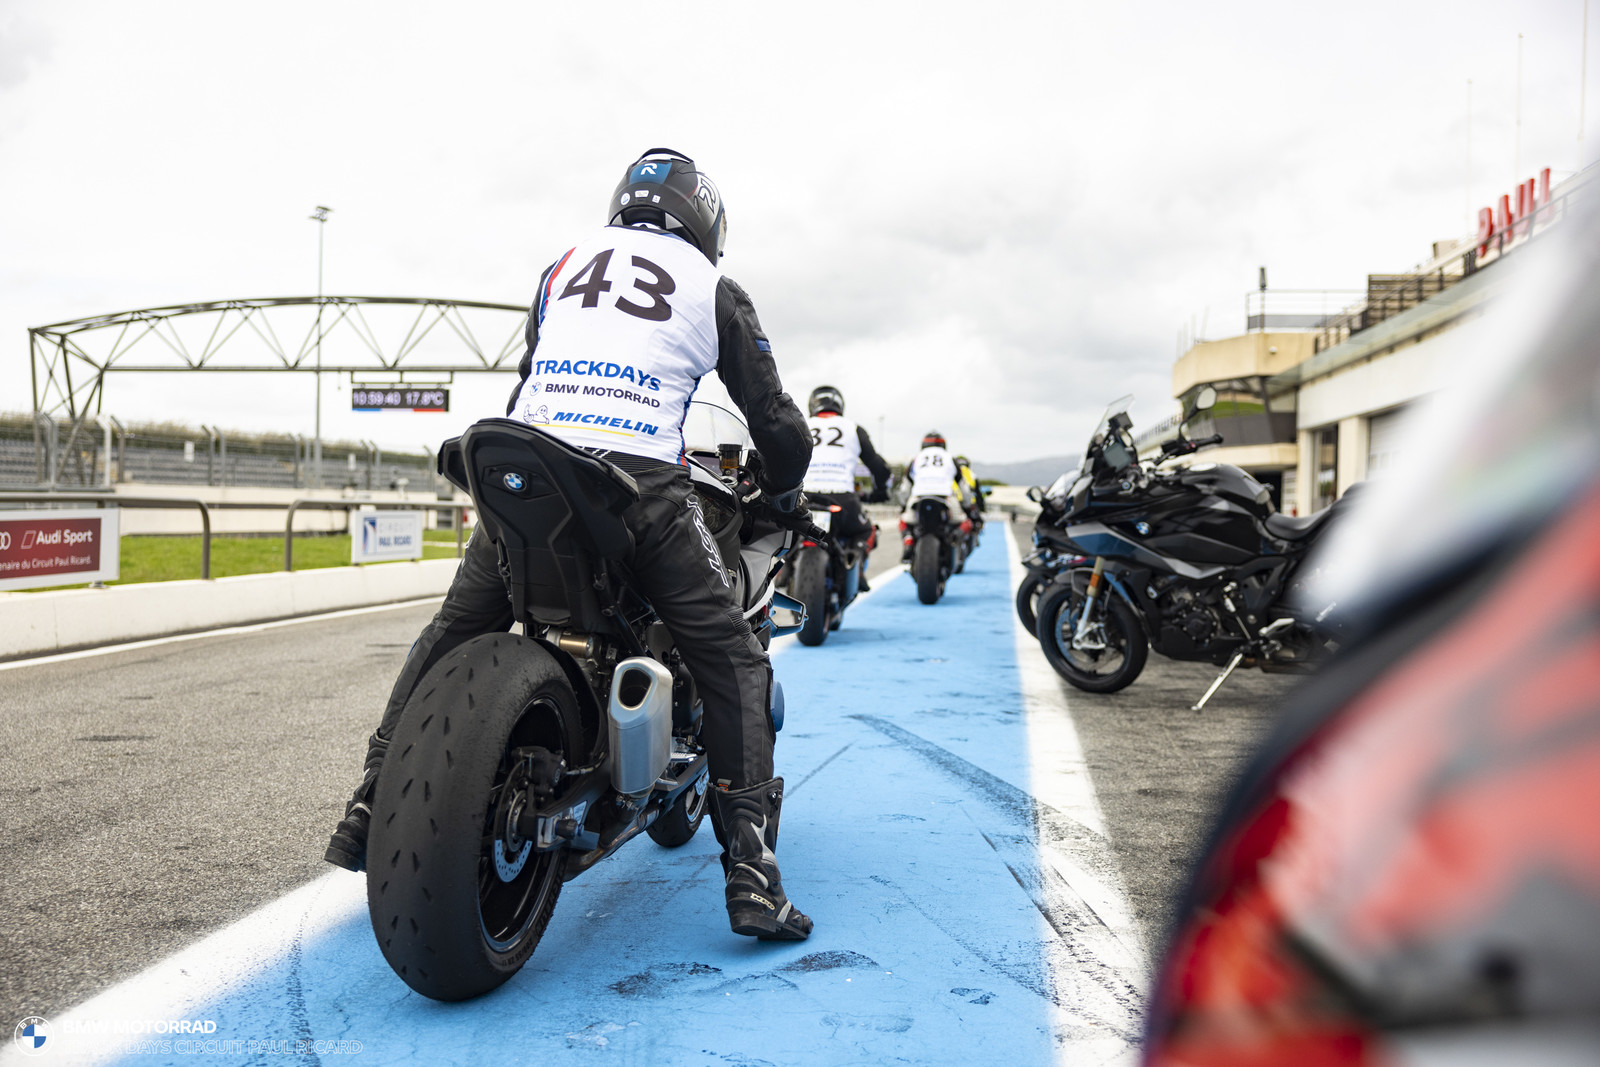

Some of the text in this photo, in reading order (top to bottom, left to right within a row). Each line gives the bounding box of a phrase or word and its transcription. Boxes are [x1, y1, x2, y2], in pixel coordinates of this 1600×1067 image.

[557, 248, 676, 322] 43
[535, 359, 662, 392] TRACKDAYS
[545, 383, 661, 409] BMW MOTORRAD
[552, 411, 659, 436] MICHELIN
[810, 427, 844, 447] 32
[36, 529, 93, 547] Audi Sport
[32, 557, 54, 569] Circuit
[54, 556, 70, 567] Paul
